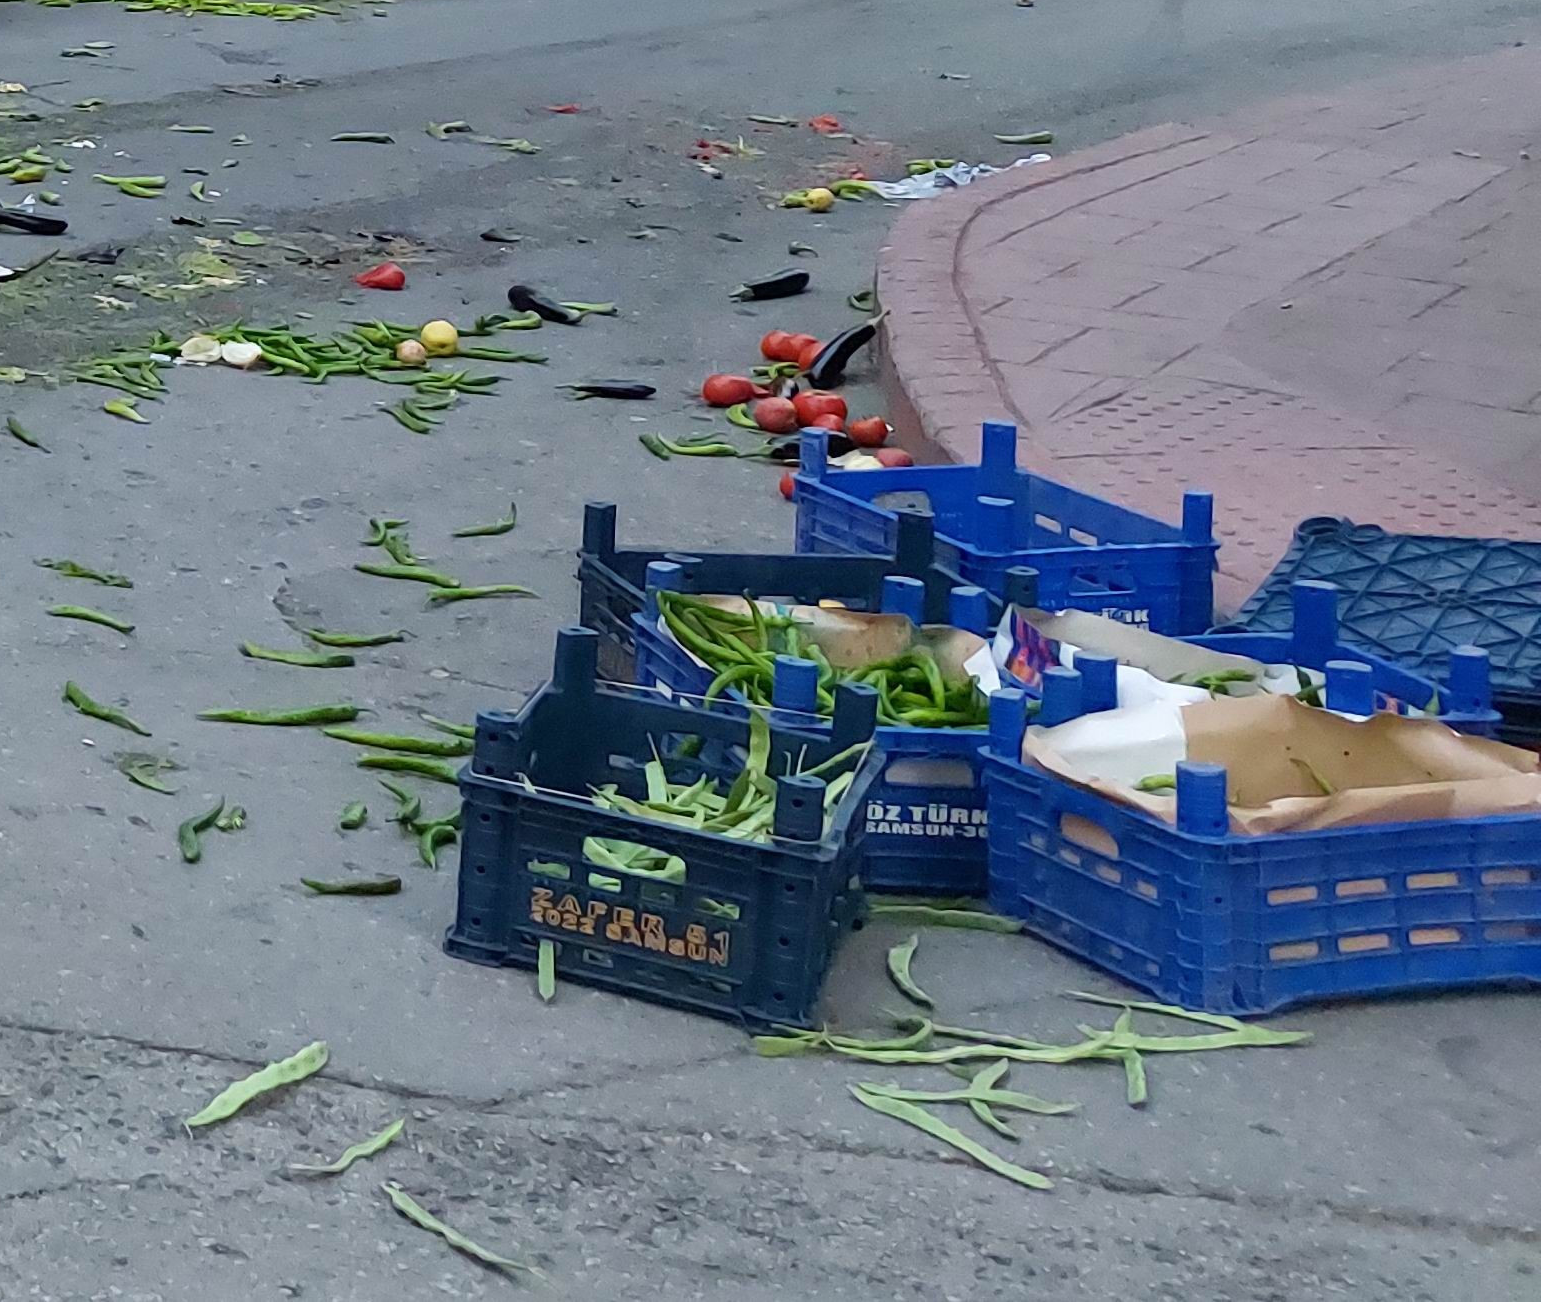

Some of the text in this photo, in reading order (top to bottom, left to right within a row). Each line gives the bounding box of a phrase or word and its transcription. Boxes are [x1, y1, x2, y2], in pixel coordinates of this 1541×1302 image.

[867, 800, 988, 824] ÖZ TÜRK
[531, 887, 665, 934] ZAFER
[605, 923, 729, 967] SAMSUN
